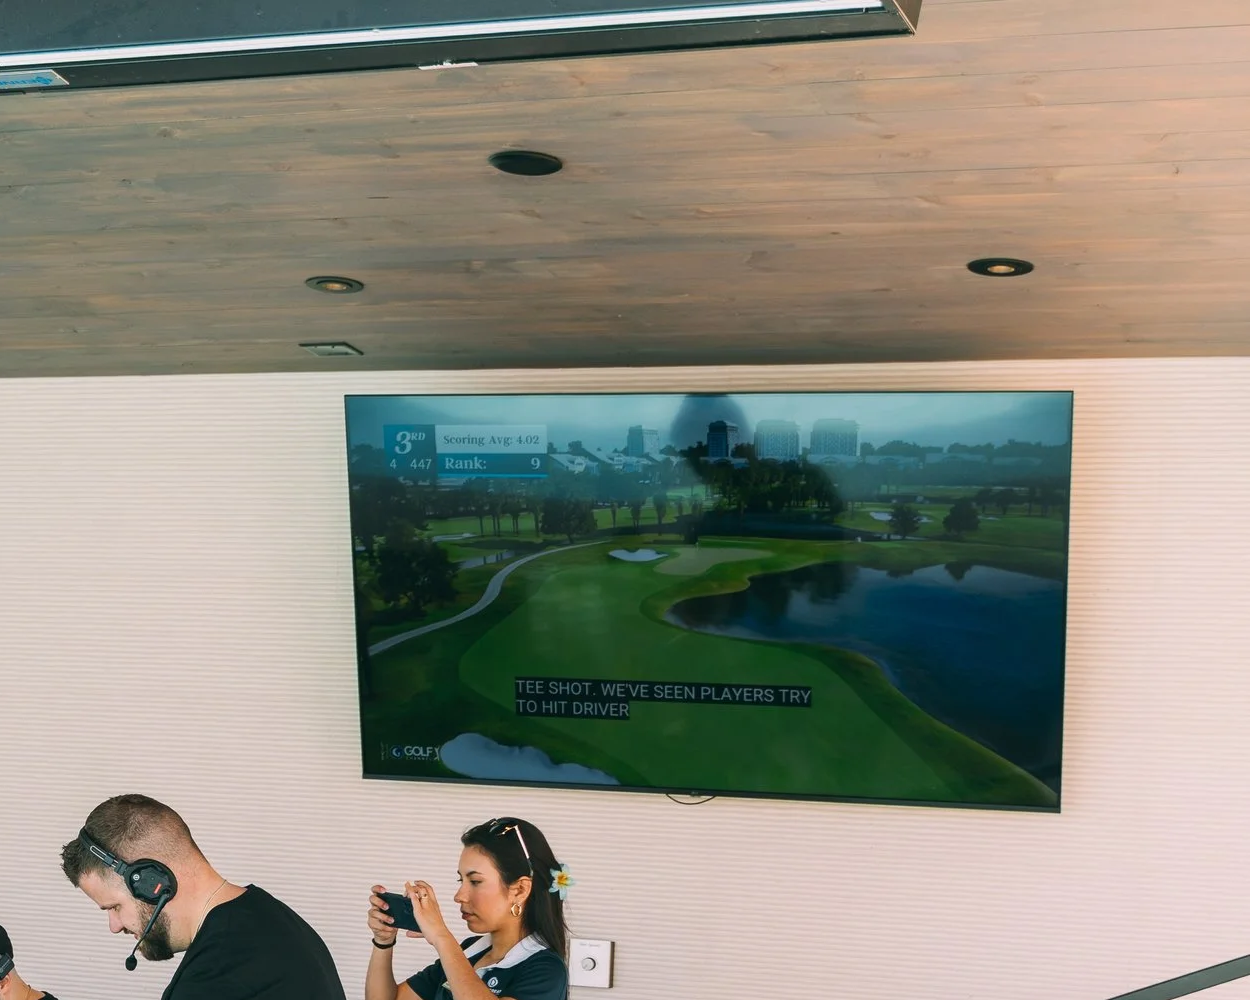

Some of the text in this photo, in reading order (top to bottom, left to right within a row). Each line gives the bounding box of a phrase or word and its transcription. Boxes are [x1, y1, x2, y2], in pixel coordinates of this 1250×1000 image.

[443, 434, 540, 447] Scoring Avg: 4.02
[389, 458, 432, 470] 4 447
[445, 457, 540, 470] Rank: 9
[515, 680, 811, 704] TEE SHOT. WE'VE SEEN PLAYERS TRY
[516, 699, 629, 716] TO HIT DRIVER
[404, 746, 432, 757] GOLF
